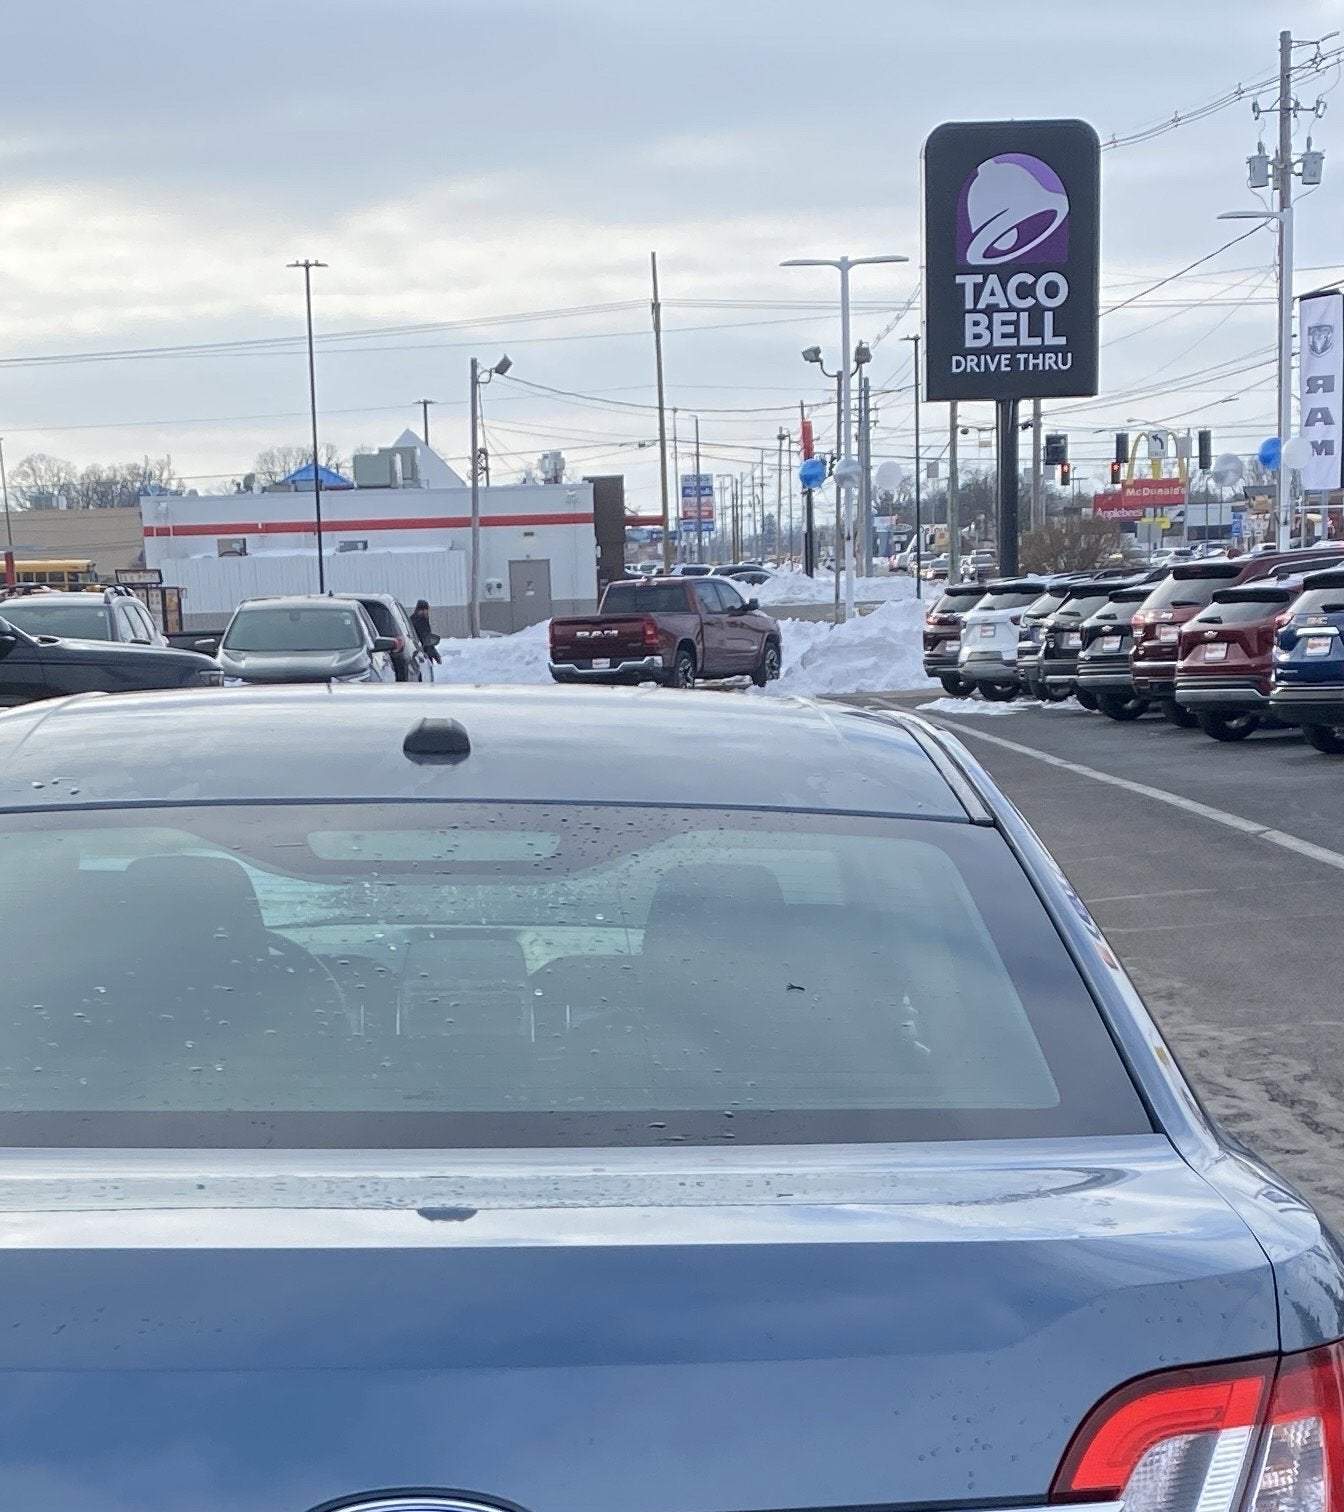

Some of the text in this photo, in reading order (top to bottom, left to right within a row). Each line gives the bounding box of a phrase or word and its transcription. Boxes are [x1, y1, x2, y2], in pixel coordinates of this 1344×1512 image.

[955, 271, 1069, 309] TACO
[964, 311, 1067, 348] BELL
[951, 352, 1073, 373] DRIVE THRU
[575, 629, 619, 639] RAM
